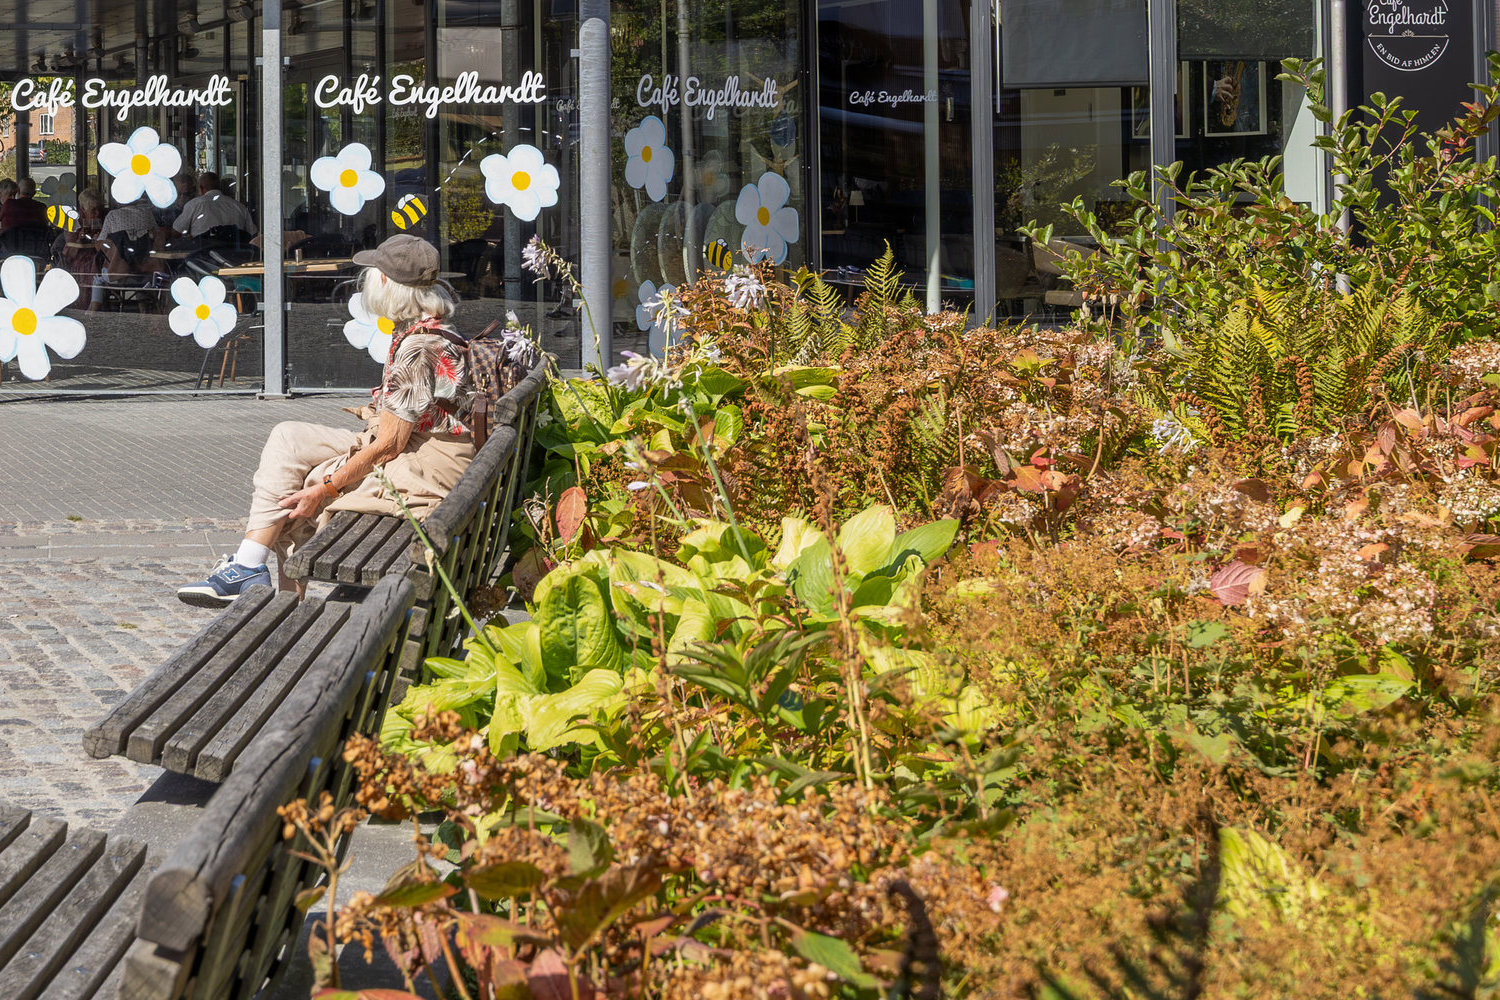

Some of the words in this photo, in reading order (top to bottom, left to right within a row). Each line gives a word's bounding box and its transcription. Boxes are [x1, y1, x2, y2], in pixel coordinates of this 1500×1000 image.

[1369, 4, 1447, 35] Engelhardt
[1376, 43, 1388, 55] EN
[1386, 53, 1400, 65] BID
[1414, 43, 1441, 67] HIMLEN
[10, 77, 76, 118] Café
[81, 74, 233, 122] Engelhardt
[314, 73, 382, 115] Café
[388, 70, 546, 119] Engelhardt
[636, 73, 681, 115] Café
[684, 75, 779, 121] Engelhardt
[849, 90, 876, 107] Café
[877, 89, 938, 108] Engelhardt
